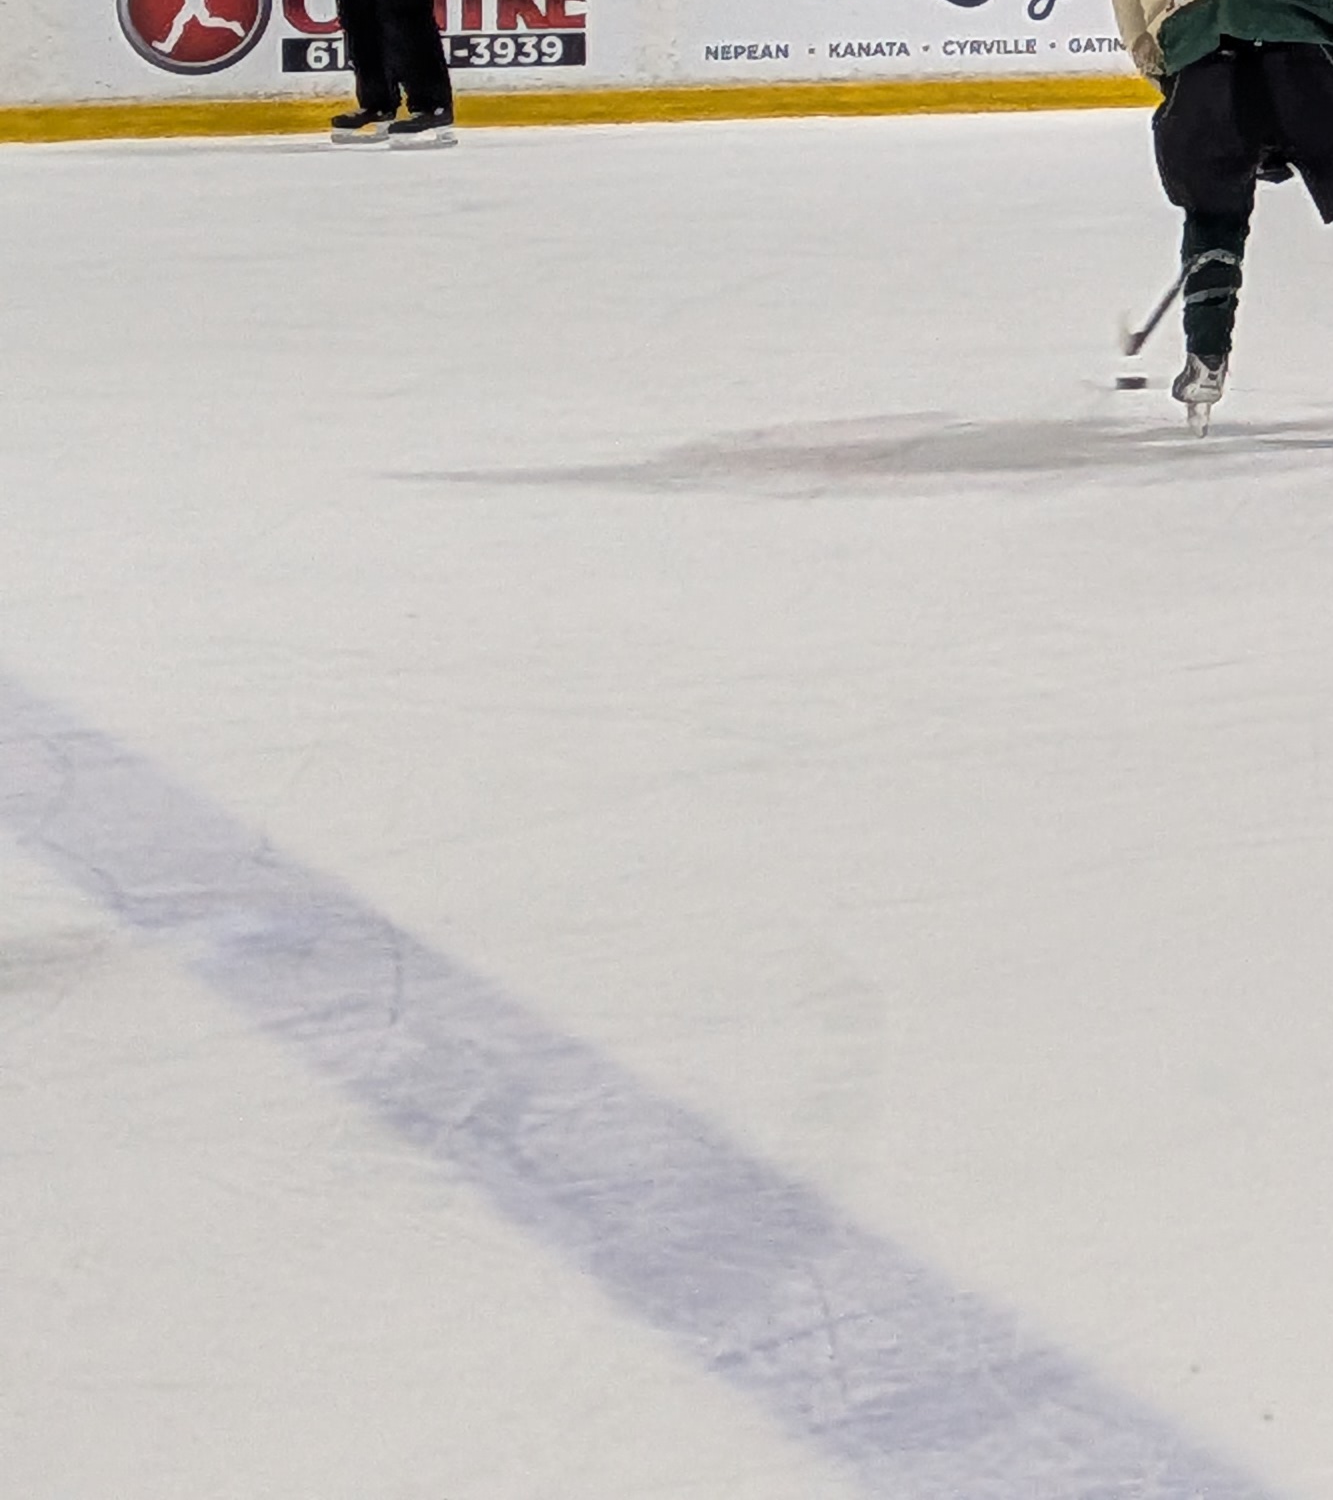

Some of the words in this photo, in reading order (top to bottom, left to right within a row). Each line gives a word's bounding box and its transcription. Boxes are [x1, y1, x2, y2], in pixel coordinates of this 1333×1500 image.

[704, 44, 790, 60] NEPEAN
[828, 41, 911, 58] KANATA
[942, 38, 1037, 56] CYRVILLE
[1068, 37, 1127, 54] GATIN
